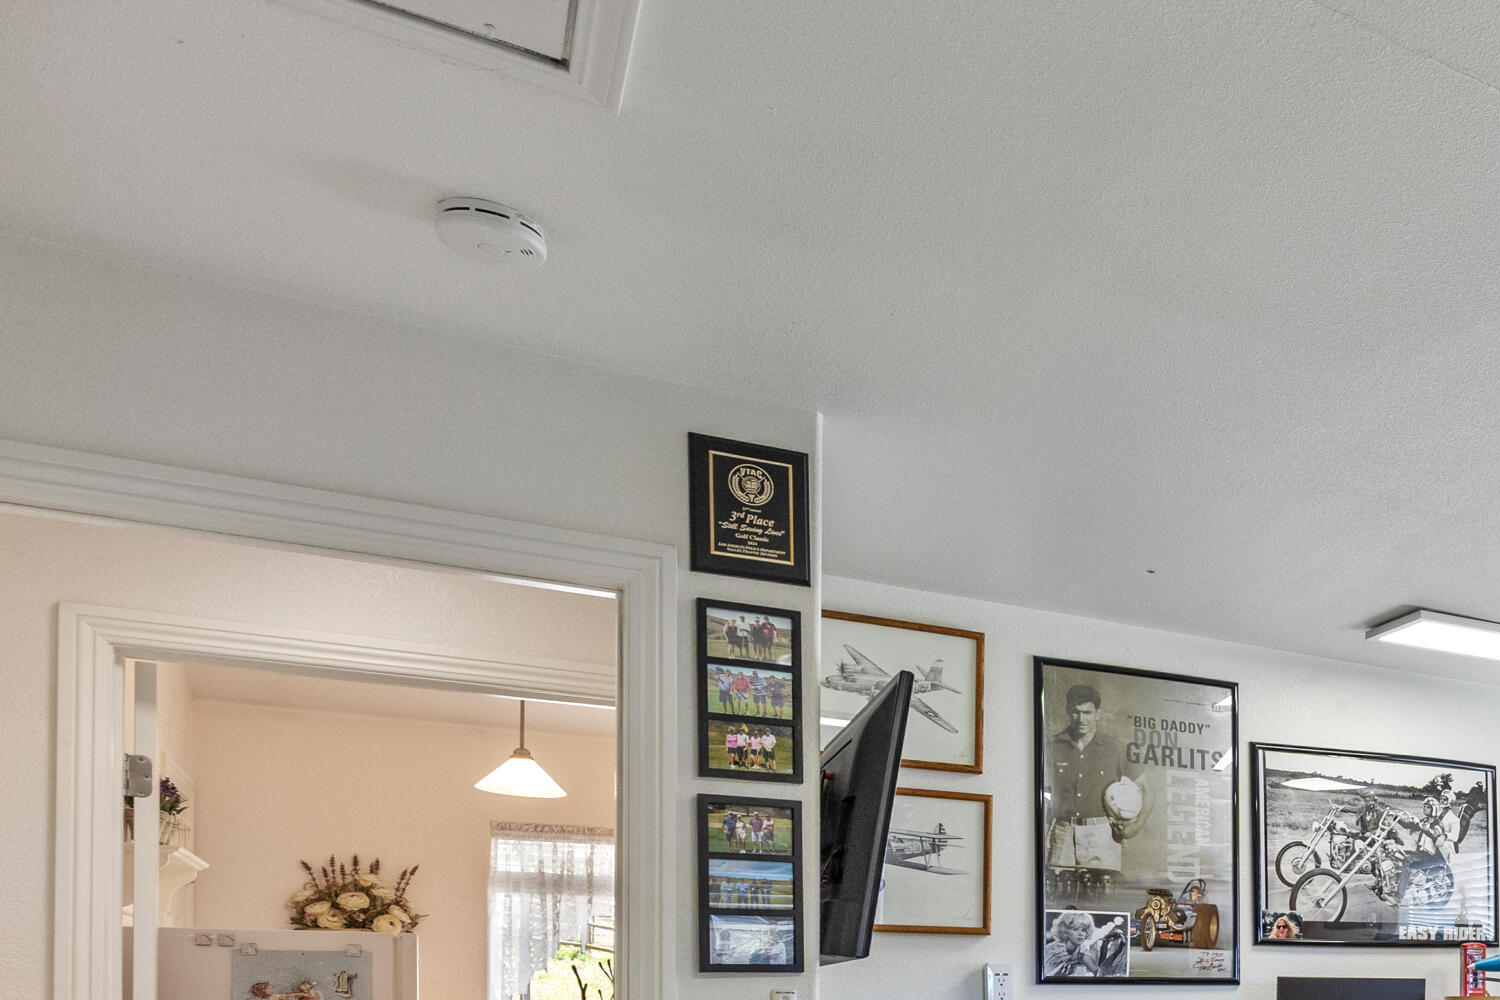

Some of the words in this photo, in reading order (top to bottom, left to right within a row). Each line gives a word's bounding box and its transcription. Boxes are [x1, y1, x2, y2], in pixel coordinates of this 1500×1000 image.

[740, 468, 762, 478] VTAC
[729, 511, 745, 521] 3rd
[746, 514, 775, 527] Place
[740, 524, 763, 535] Saving
[750, 534, 769, 542] Classic
[1127, 714, 1156, 730] "BIG
[1161, 719, 1210, 735] DADDY"
[1134, 728, 1178, 750] DON
[1126, 742, 1222, 772] GARLITS
[1194, 778, 1210, 847] AMERICAN
[1166, 768, 1201, 883] LEGEND
[1398, 926, 1436, 940] EASY
[1443, 926, 1486, 941] RIDER
